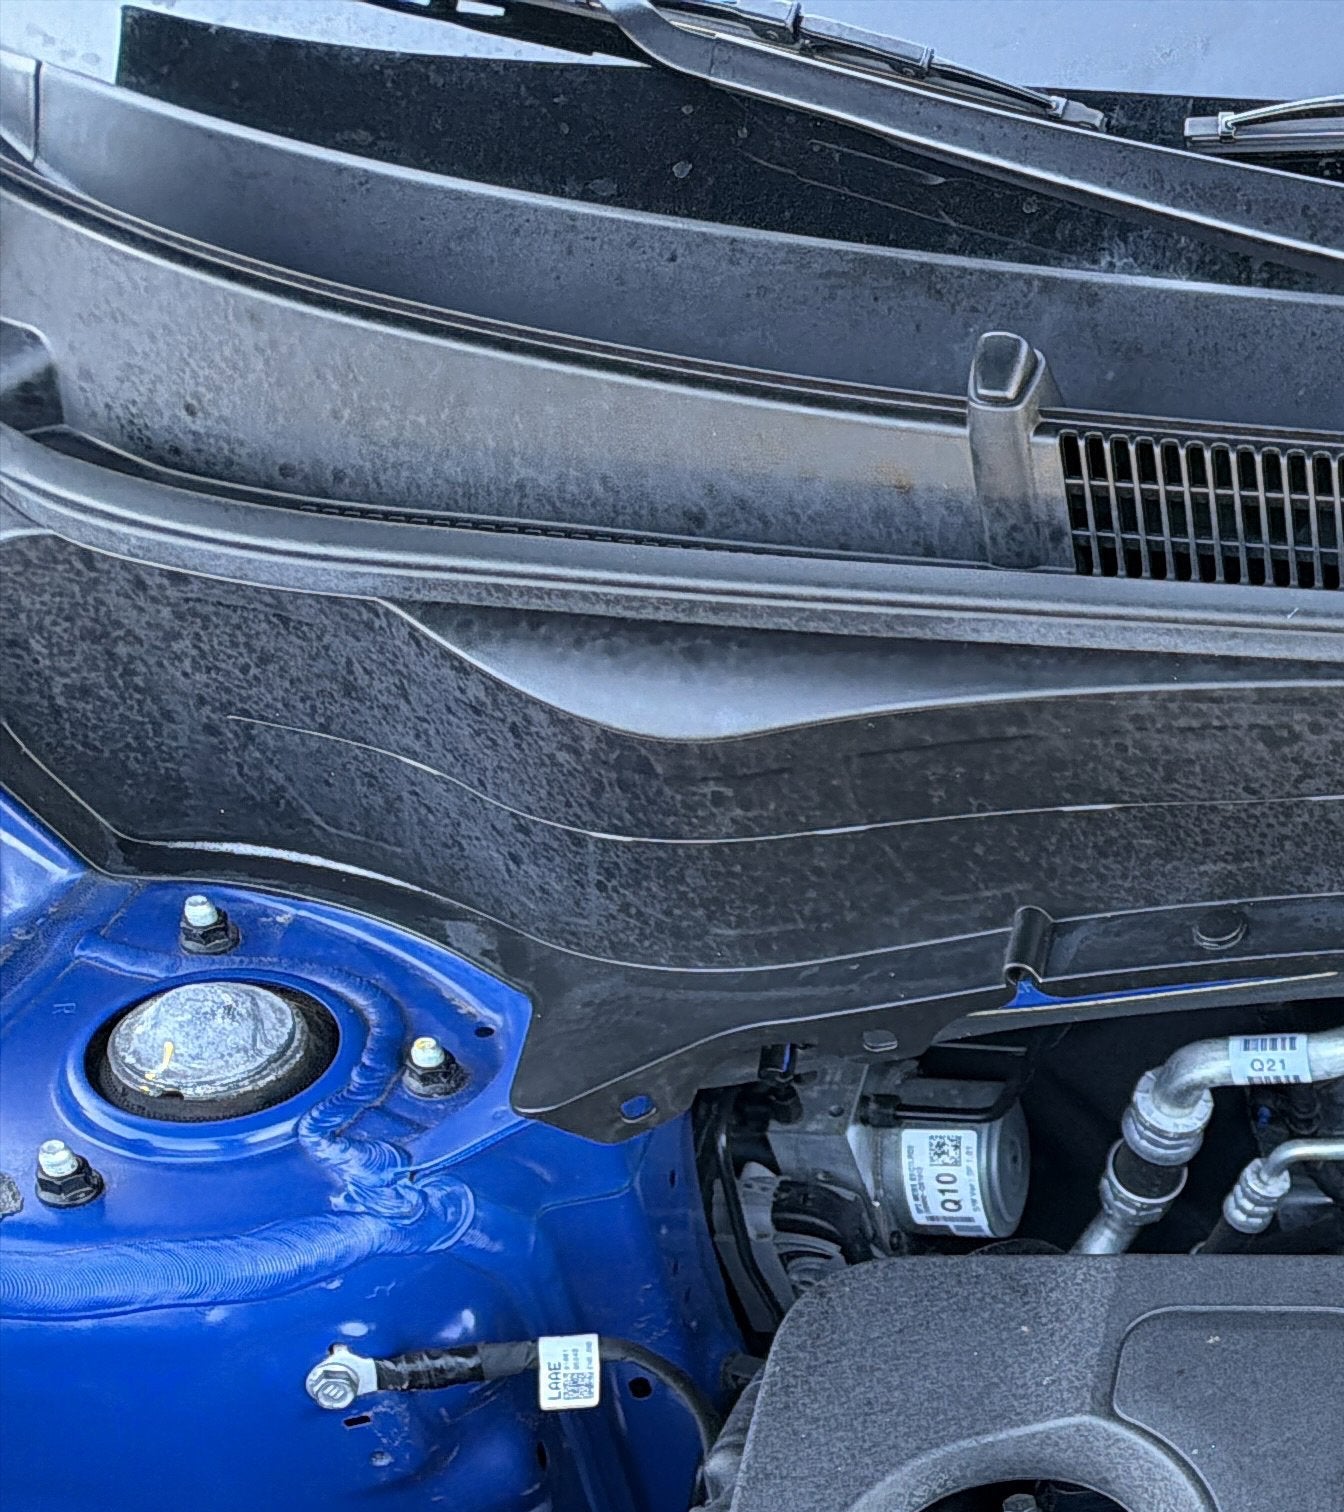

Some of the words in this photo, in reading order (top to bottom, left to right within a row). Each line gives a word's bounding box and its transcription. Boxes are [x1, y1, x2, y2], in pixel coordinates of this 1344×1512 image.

[1250, 1058, 1286, 1072] Q21
[935, 1172, 964, 1212] Q10
[547, 1361, 562, 1400] LAAE
